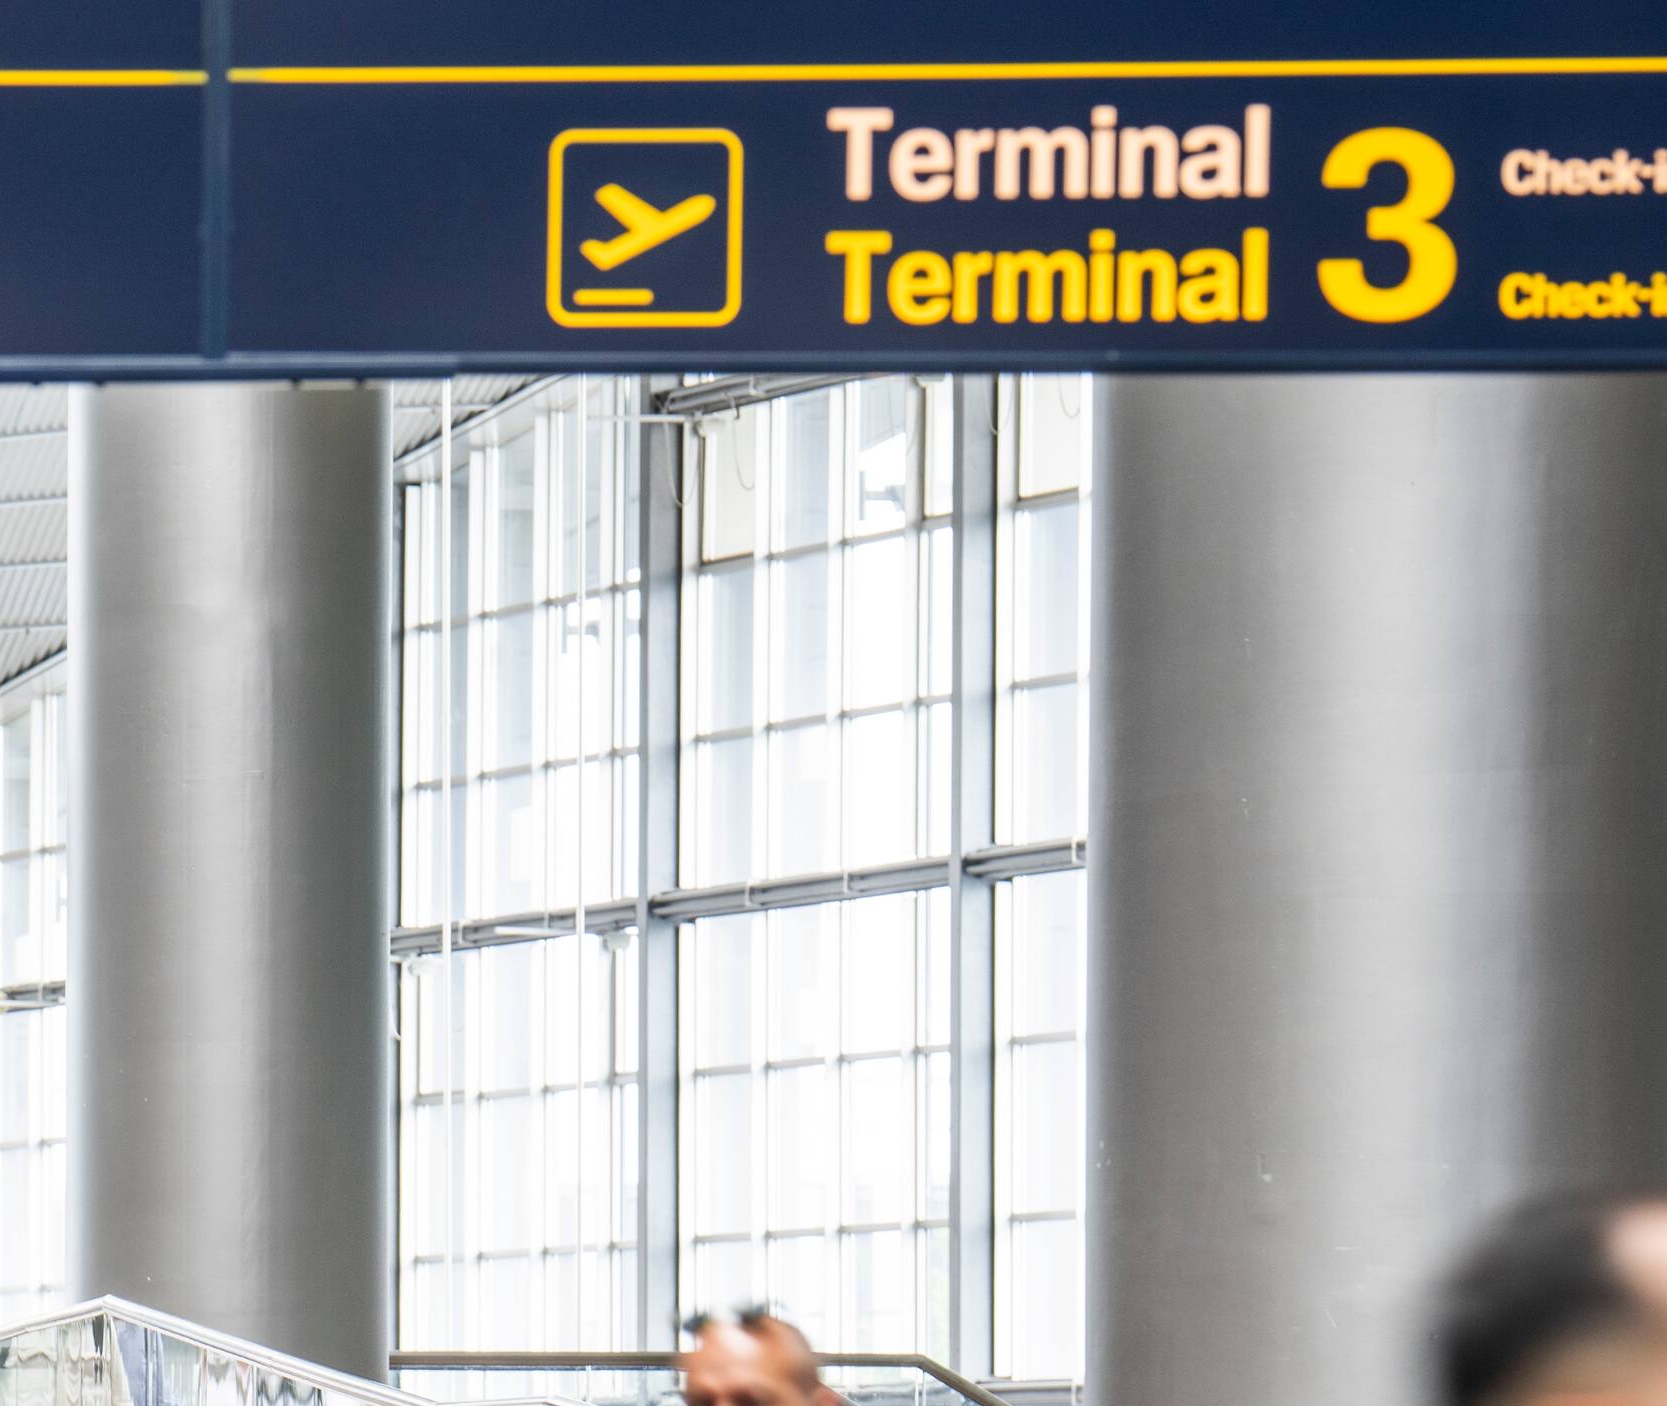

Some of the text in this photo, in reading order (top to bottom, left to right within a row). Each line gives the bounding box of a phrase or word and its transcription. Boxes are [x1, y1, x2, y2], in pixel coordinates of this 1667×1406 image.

[826, 103, 1272, 203] Terminal
[1316, 126, 1458, 324] 3
[824, 227, 1271, 327] Terminal
